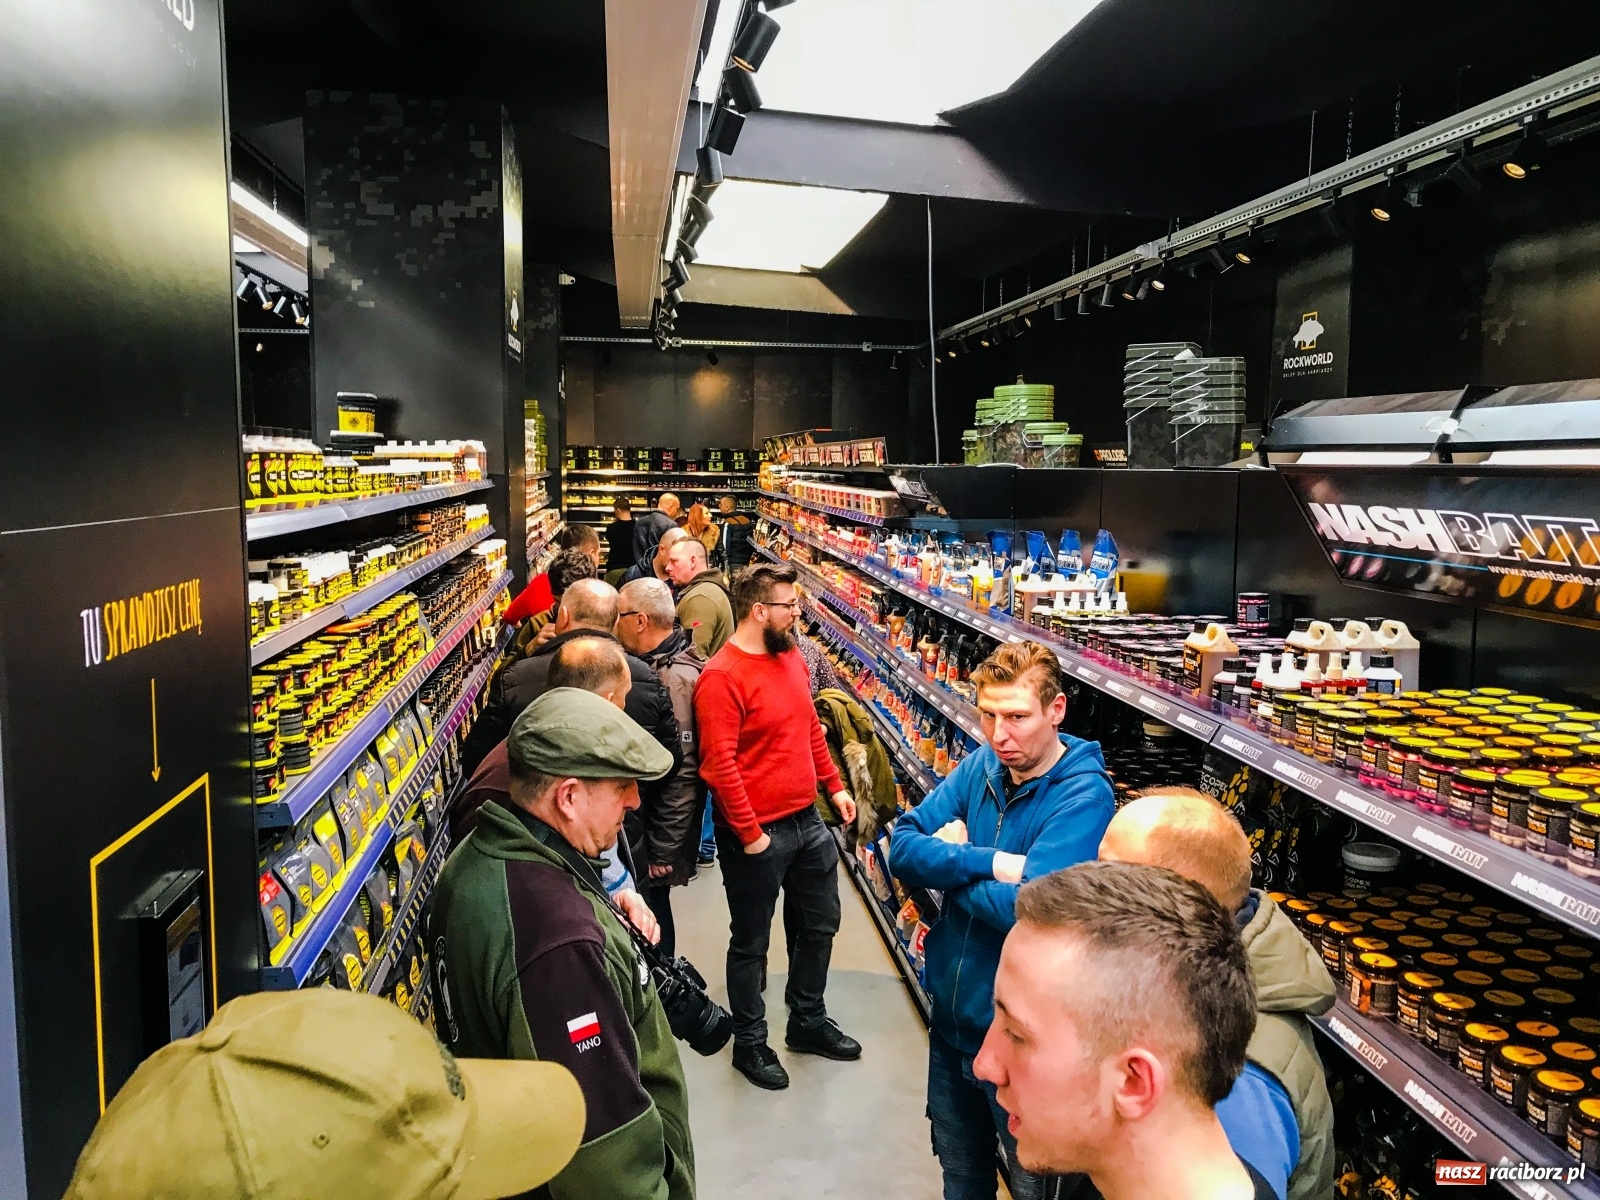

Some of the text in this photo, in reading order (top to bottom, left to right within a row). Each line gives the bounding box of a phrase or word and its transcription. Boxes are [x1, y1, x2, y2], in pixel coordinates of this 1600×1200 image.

[1283, 352, 1334, 370] ROCKWORLD
[1098, 449, 1127, 462] PROLOGIC
[80, 578, 203, 668] TU SPRAWDZISZ CENĘ
[1200, 782, 1220, 798] QUID
[575, 1035, 602, 1054] YANO
